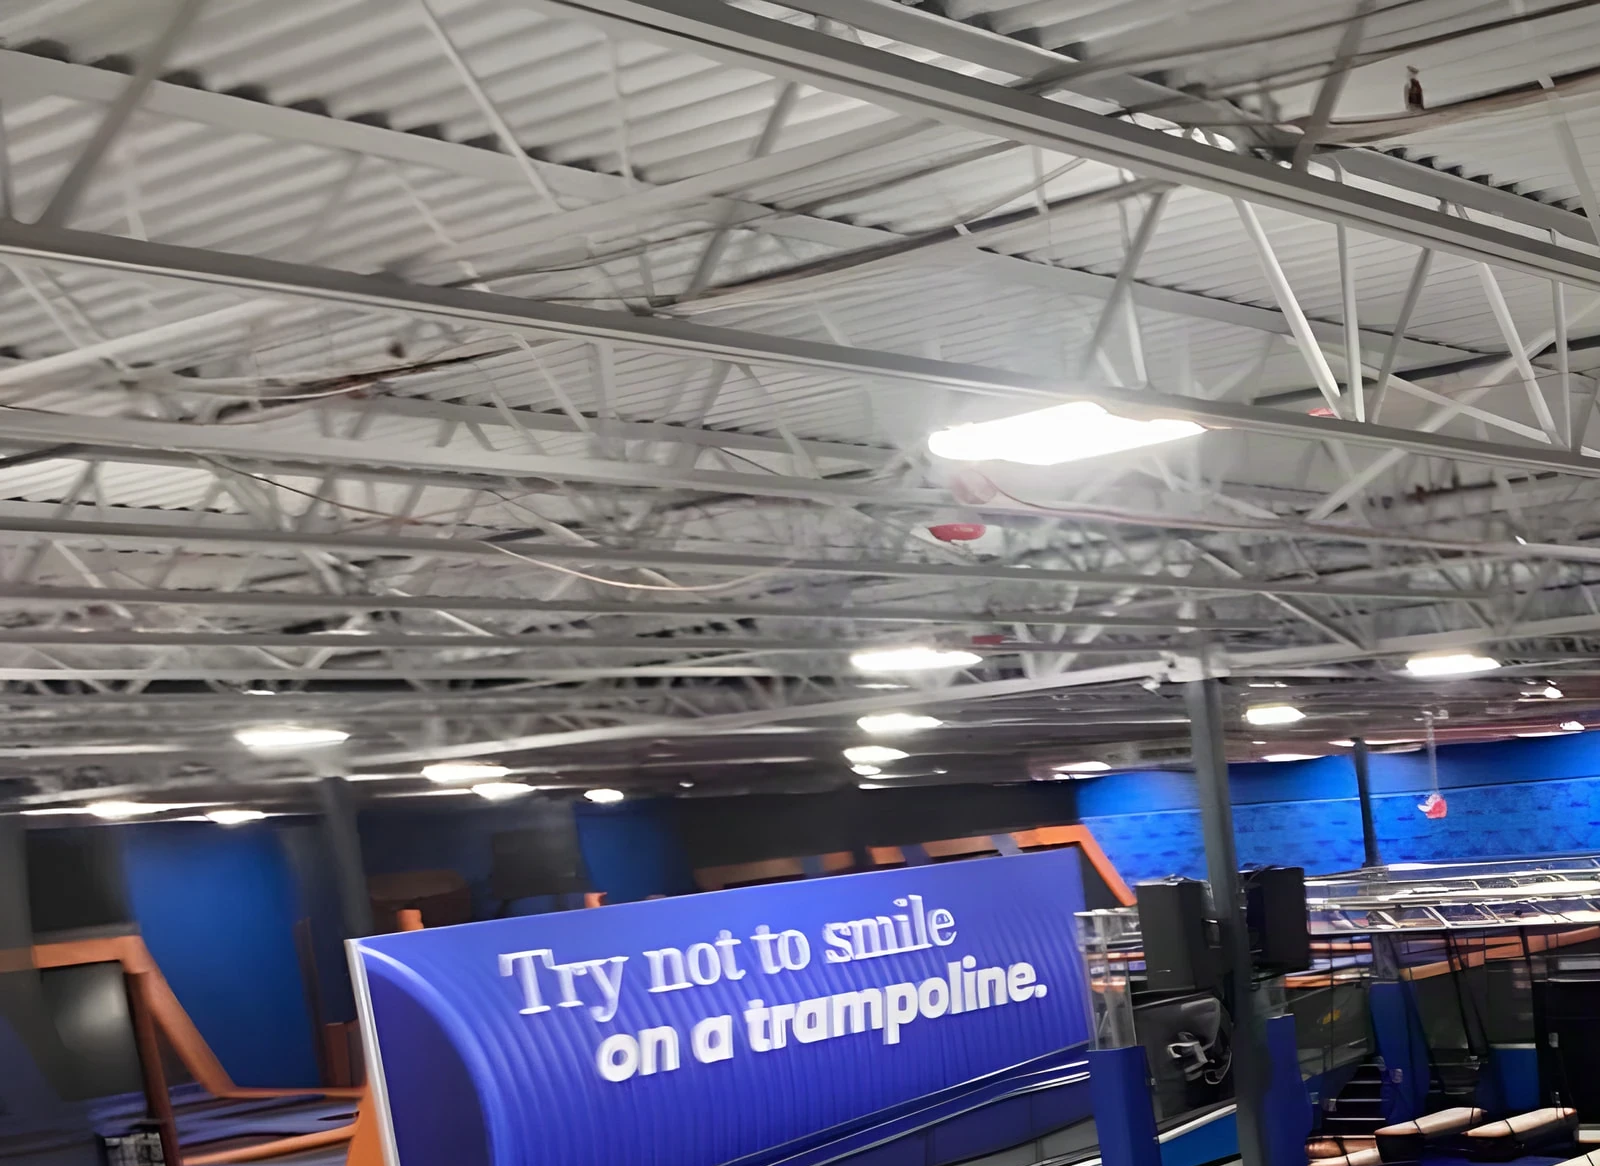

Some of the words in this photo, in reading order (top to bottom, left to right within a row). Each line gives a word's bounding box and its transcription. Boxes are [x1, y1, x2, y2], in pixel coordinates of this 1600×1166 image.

[498, 948, 630, 1022] Try
[642, 929, 747, 993] not
[749, 924, 811, 975] to
[821, 894, 957, 964] smile
[596, 1025, 681, 1082] on
[690, 1014, 734, 1064] a
[743, 954, 1048, 1053] trampoline.
